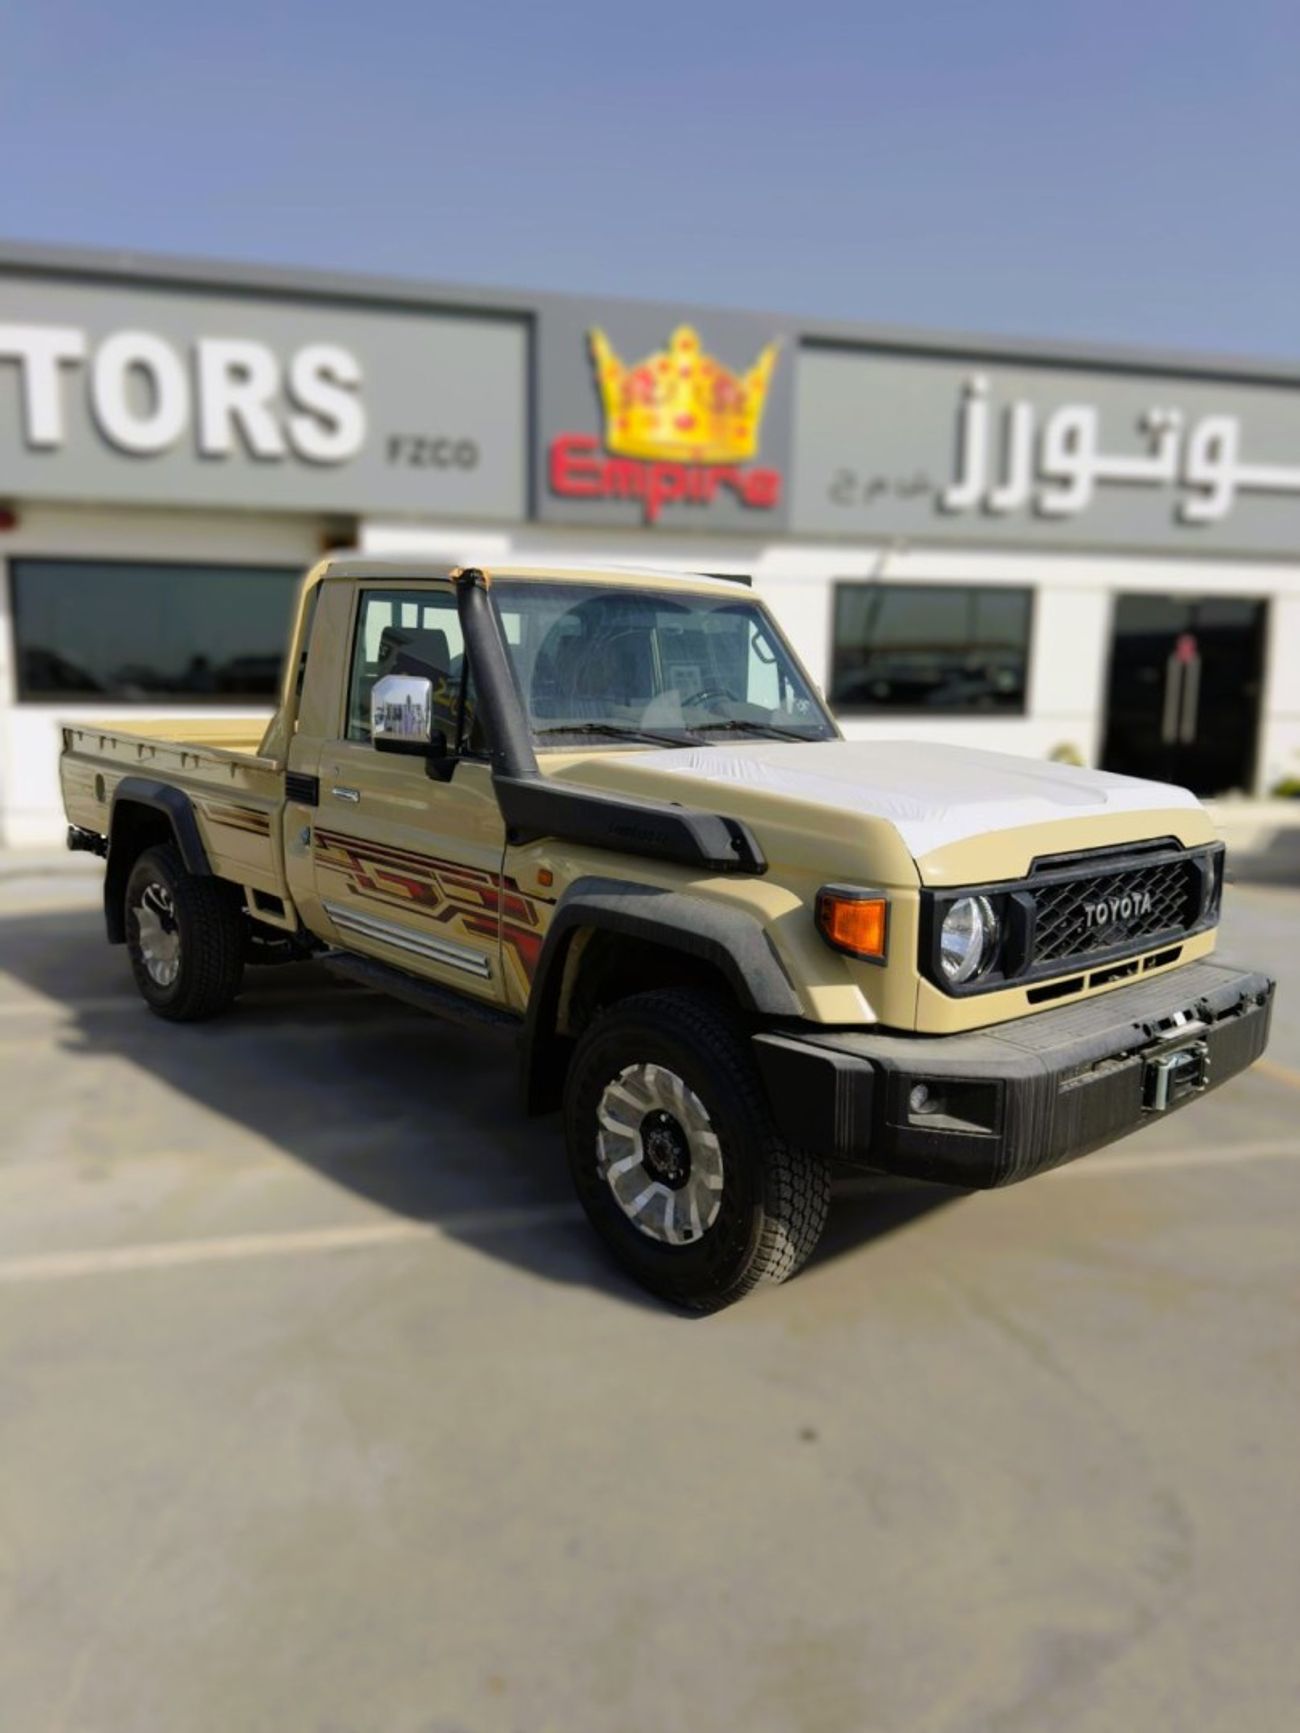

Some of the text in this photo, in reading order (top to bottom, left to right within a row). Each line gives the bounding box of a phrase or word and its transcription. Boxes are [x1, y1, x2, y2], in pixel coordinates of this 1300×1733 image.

[0, 324, 481, 471] TORS FZCO
[943, 373, 1300, 521] وتورز
[550, 434, 782, 522] Empire
[1082, 891, 1152, 928] TOYOTA
